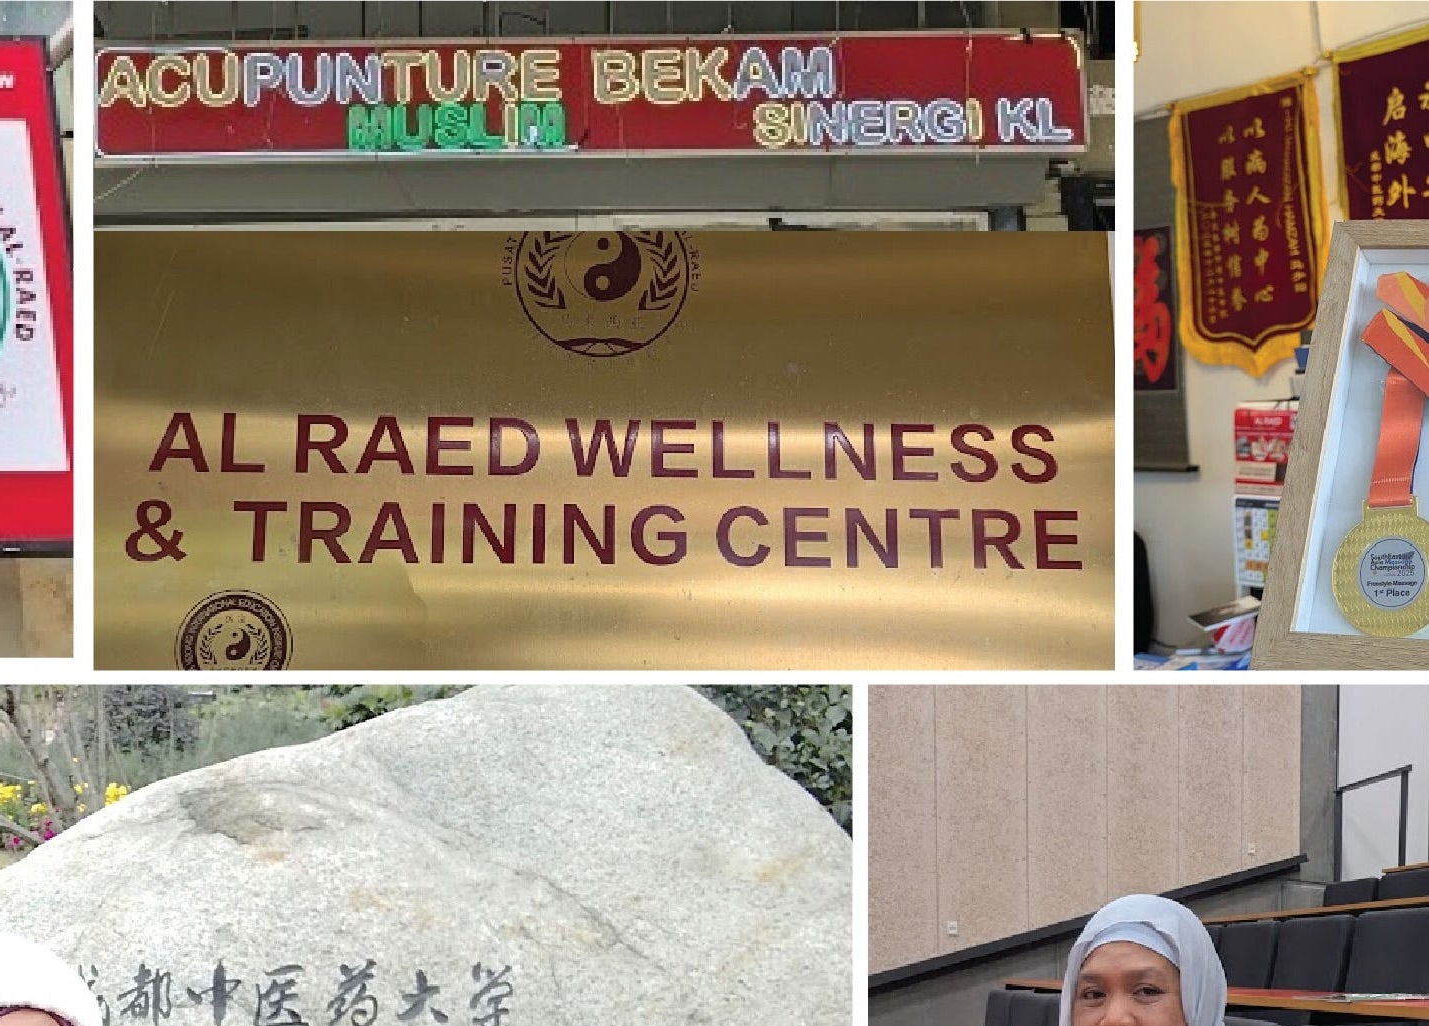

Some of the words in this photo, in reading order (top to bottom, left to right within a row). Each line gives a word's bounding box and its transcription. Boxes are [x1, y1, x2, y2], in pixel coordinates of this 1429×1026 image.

[97, 50, 563, 108] ACUPUNTURE
[590, 46, 836, 104] BEKAM
[346, 103, 569, 152] MUSLIM
[751, 98, 984, 146] SINERGI
[995, 98, 1075, 144] KL
[147, 411, 267, 475] AL
[293, 413, 542, 477] RAED
[564, 417, 1061, 483] WELLNESS
[124, 498, 188, 563] &
[233, 500, 690, 566] TRAINING
[714, 505, 1084, 571] CENTRE
[1386, 588, 1411, 597] Place
